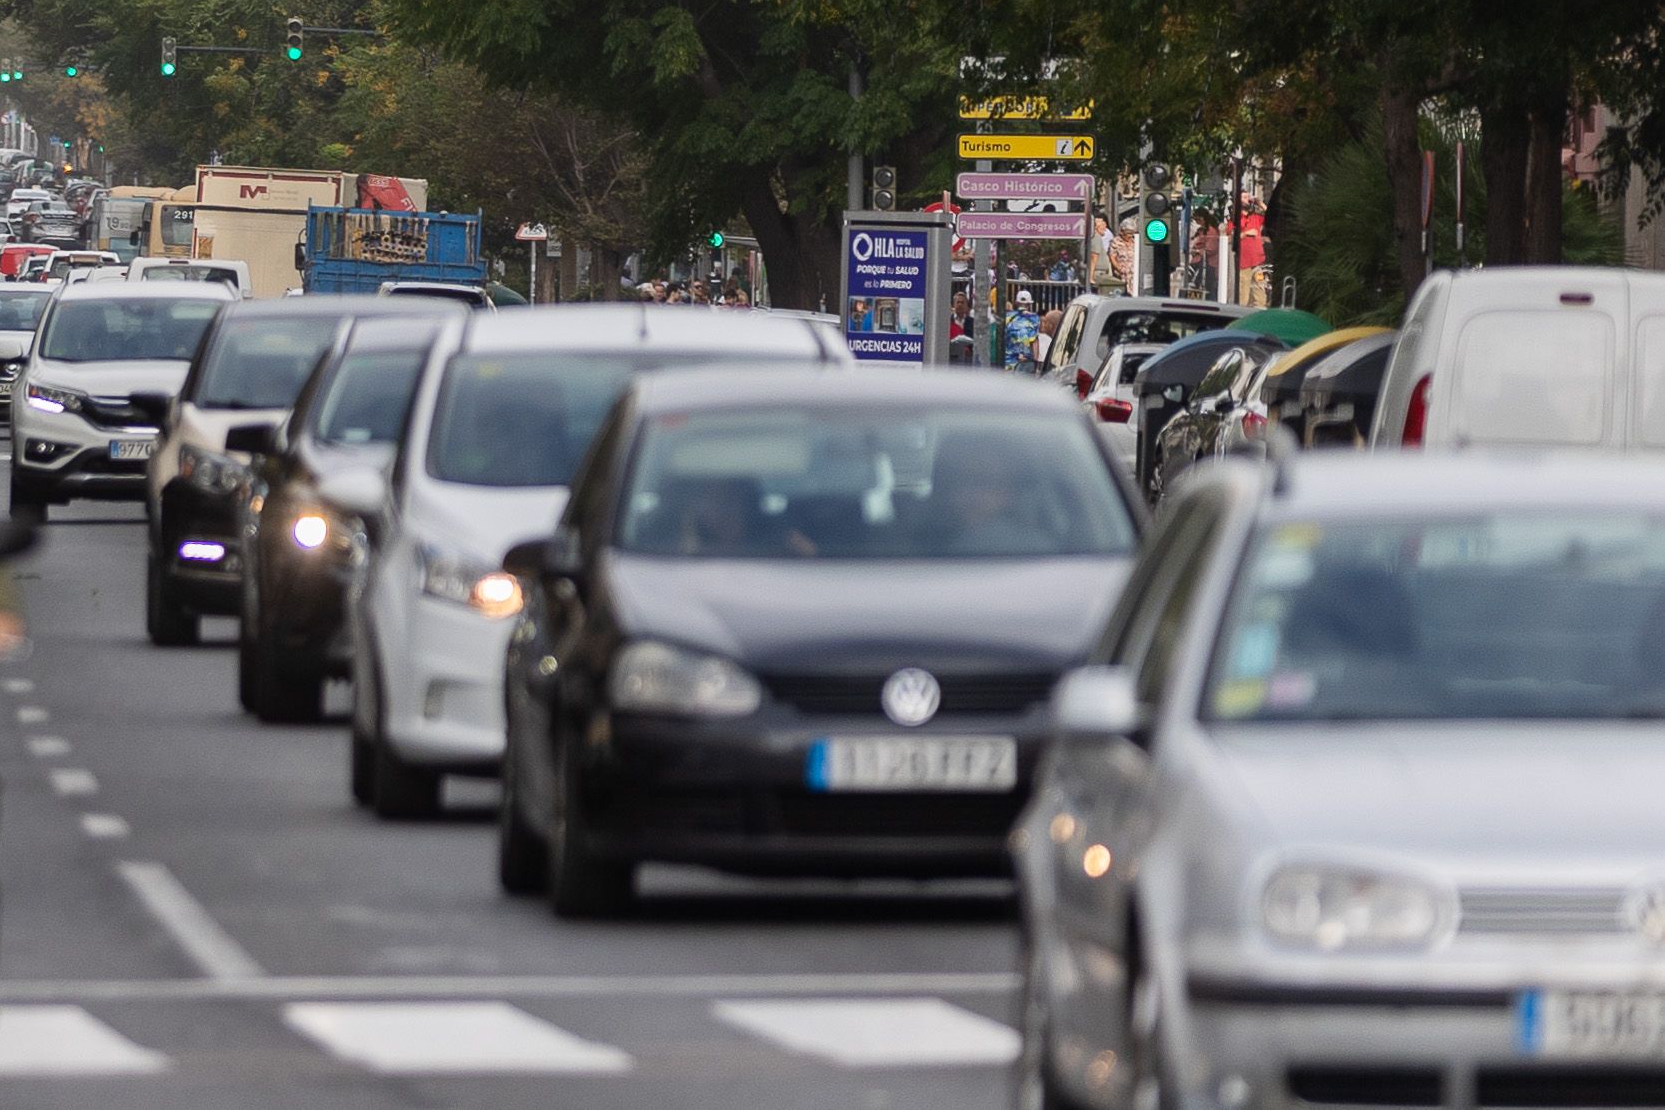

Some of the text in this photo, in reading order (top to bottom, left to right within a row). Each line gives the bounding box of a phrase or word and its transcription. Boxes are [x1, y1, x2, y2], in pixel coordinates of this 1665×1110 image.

[962, 140, 1011, 152] Turismo
[960, 180, 1000, 192] Casco
[175, 210, 194, 220] 291
[959, 220, 1072, 233] Palacio de Congresos
[874, 237, 895, 259] HLA
[895, 246, 925, 260] LA SALUD
[856, 264, 887, 276] PORQUE
[895, 266, 920, 276] SALUD
[879, 279, 913, 290] PRIMERO
[848, 339, 922, 354] URGENCIAS 24H
